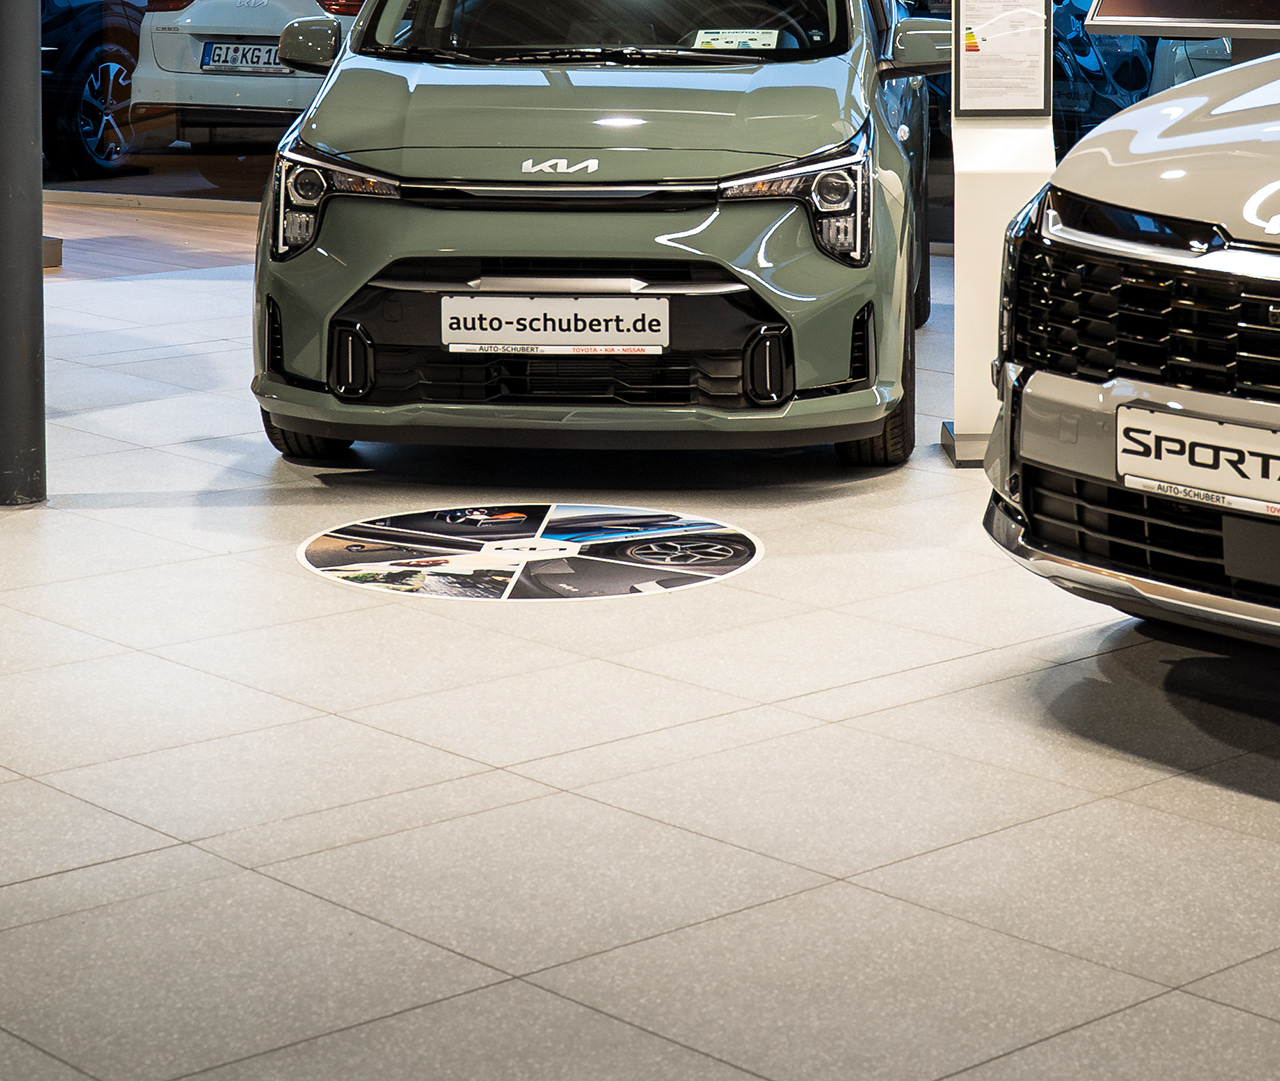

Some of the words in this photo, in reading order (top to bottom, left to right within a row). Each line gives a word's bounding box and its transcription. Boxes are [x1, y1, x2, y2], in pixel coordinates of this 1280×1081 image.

[211, 46, 231, 64] GI
[240, 47, 262, 65] KG
[448, 312, 662, 334] auto-schubert.de
